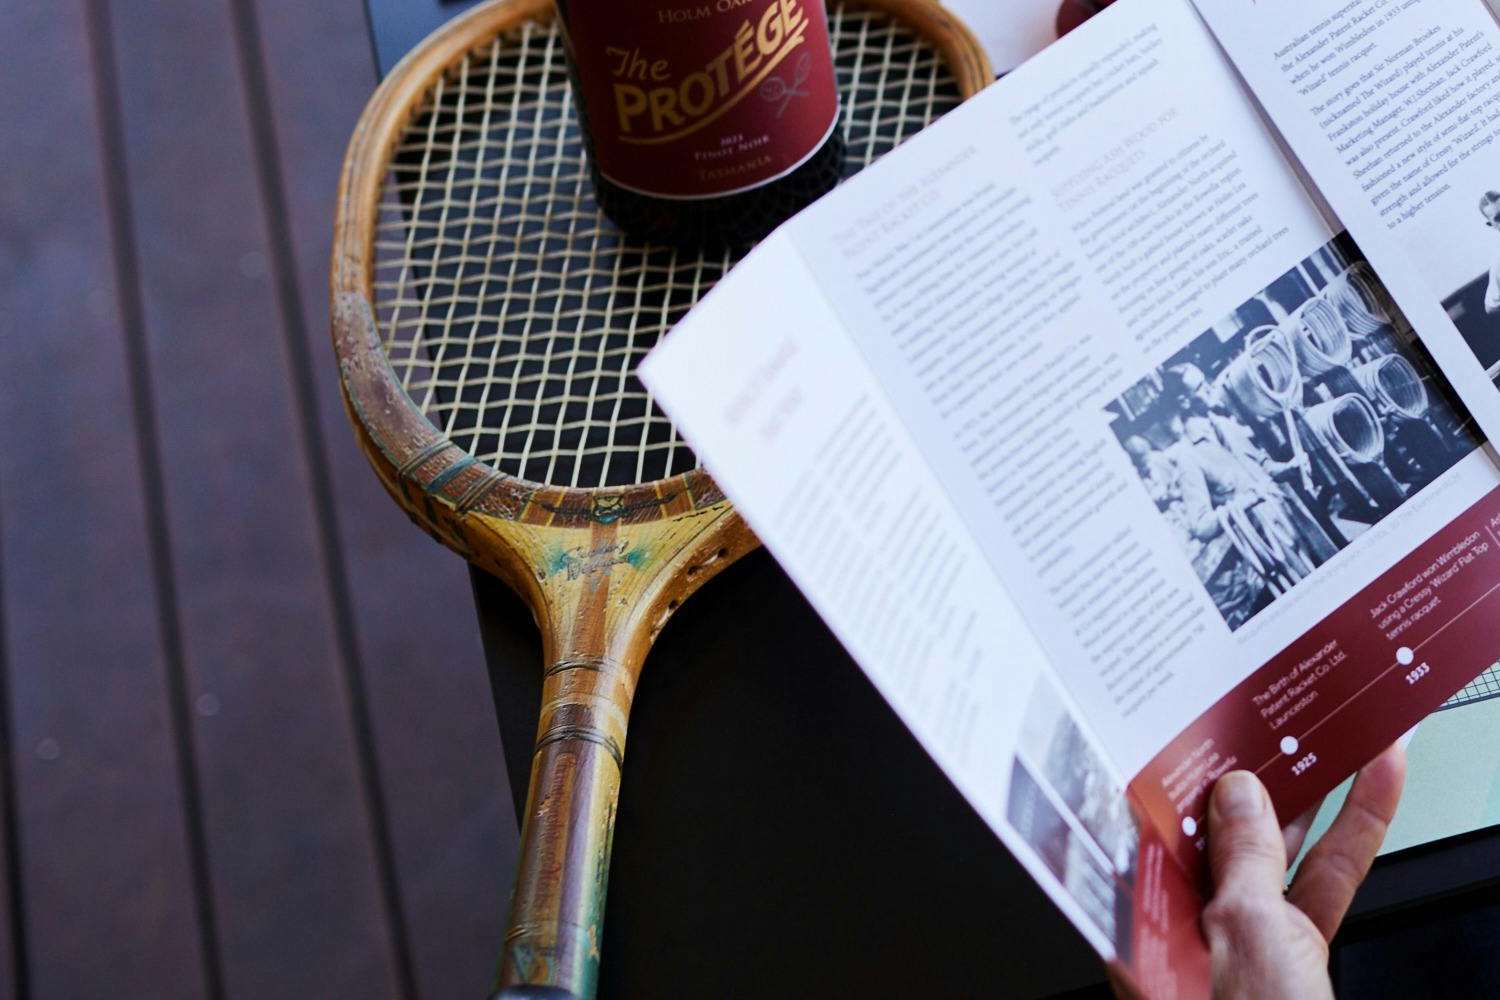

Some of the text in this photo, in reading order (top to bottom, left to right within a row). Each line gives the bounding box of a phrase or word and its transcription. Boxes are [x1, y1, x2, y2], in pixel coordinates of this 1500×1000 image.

[658, 5, 711, 24] HOLM
[606, 46, 671, 80] The
[1370, 531, 1481, 619] Jack Crawford won Wimbledon
[1378, 610, 1402, 630] using
[1399, 605, 1407, 614] a
[1403, 586, 1432, 609] Cressy
[1457, 552, 1475, 567] Flat
[1471, 542, 1489, 555] Top
[1405, 662, 1430, 685] 1933
[1291, 752, 1317, 776] 1925
